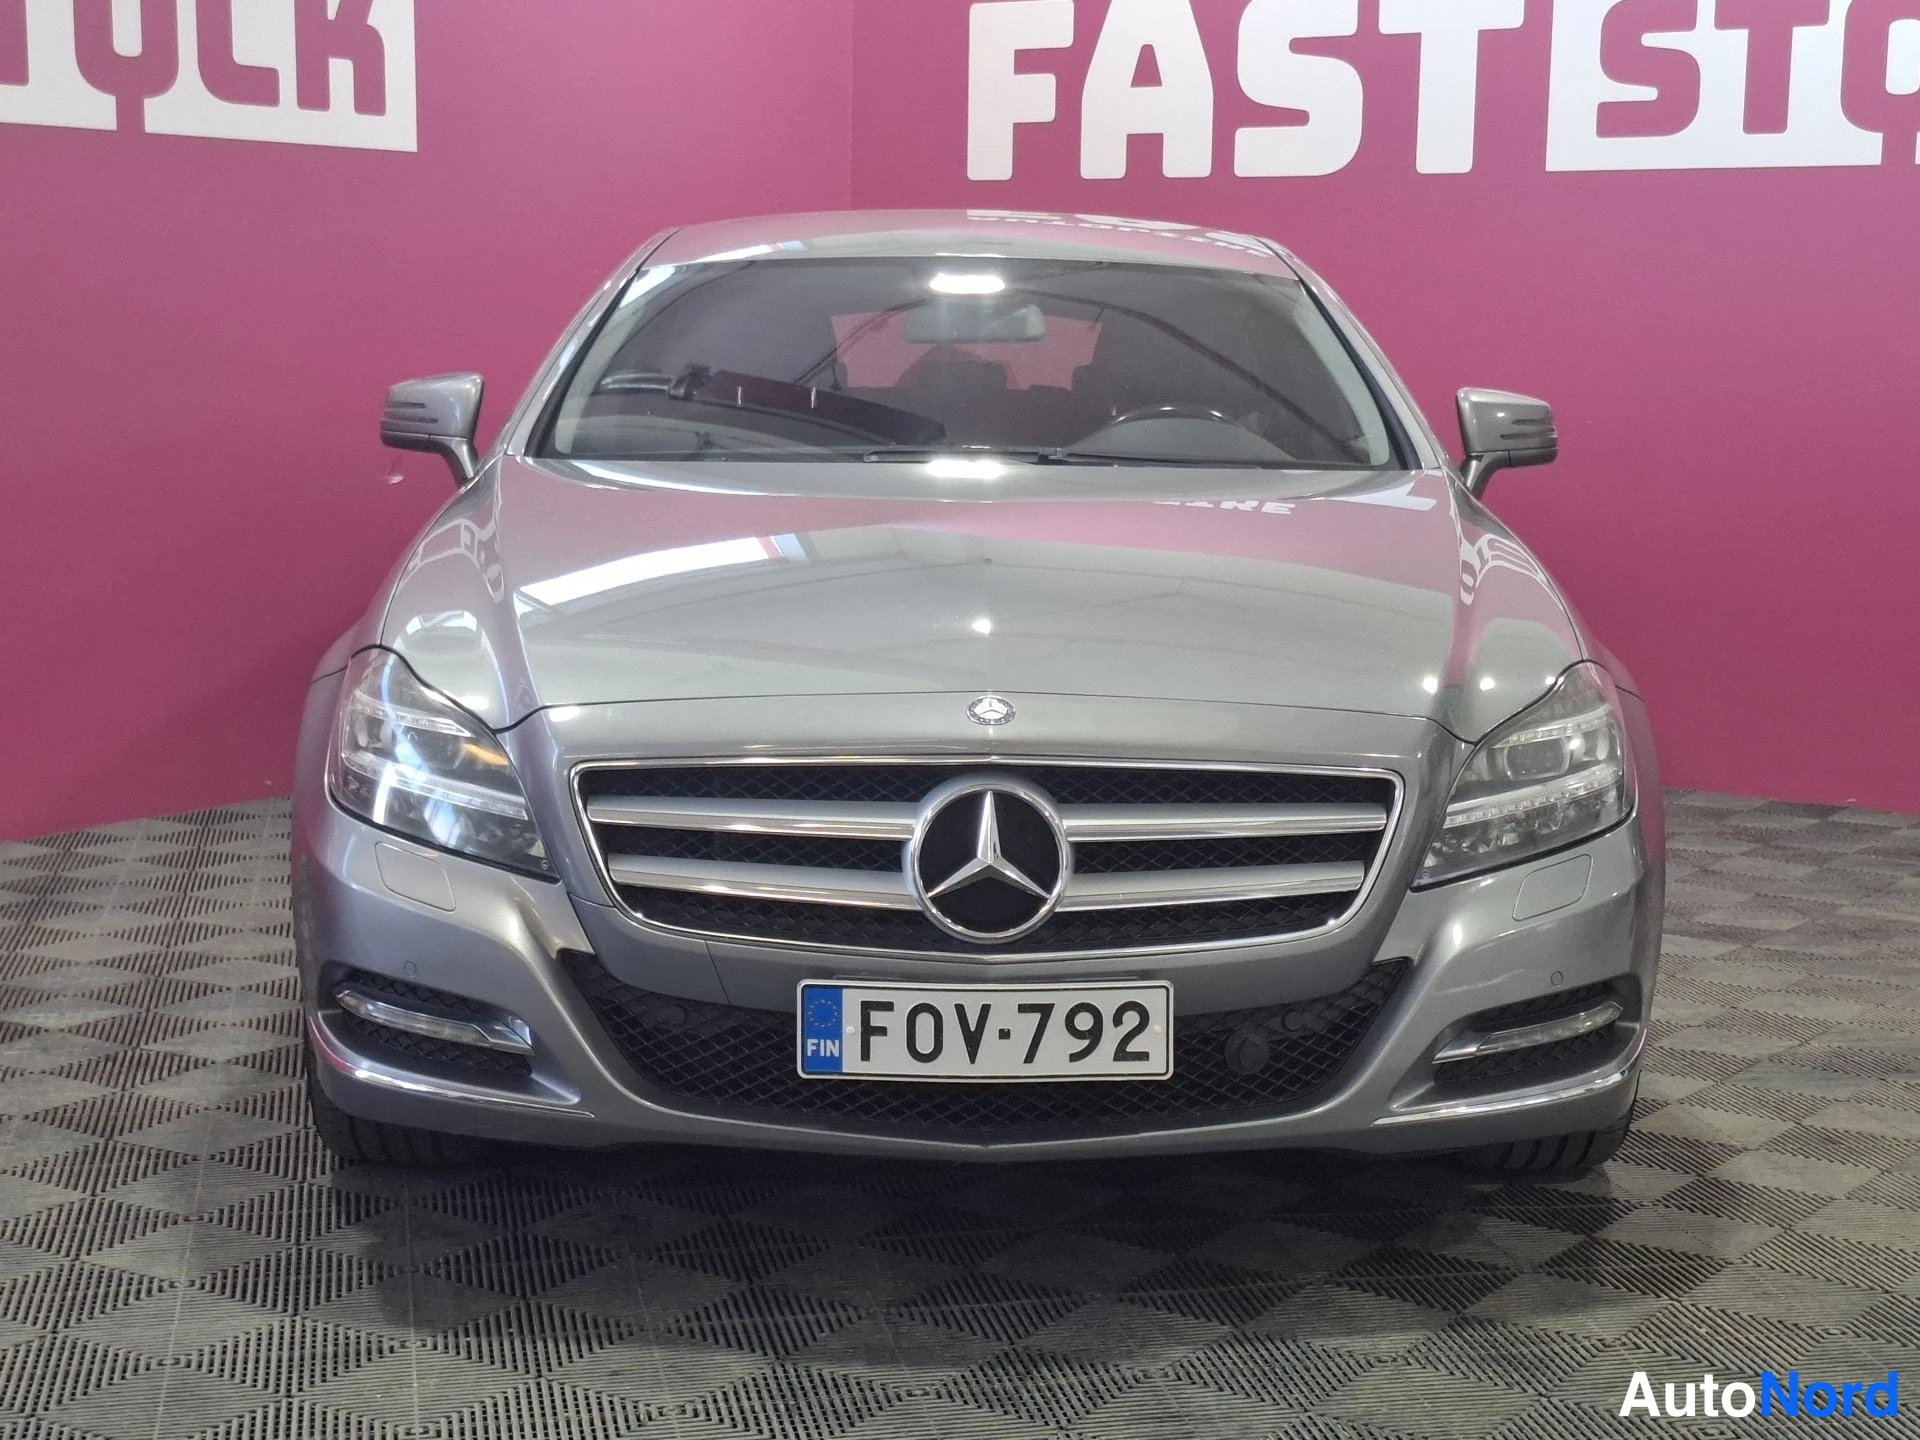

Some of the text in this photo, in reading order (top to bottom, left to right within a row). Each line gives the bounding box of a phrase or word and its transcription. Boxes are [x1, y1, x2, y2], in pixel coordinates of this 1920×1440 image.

[0, 0, 387, 117] OCK
[967, 0, 1525, 181] FAST
[806, 1038, 840, 1058] FIN
[859, 1000, 1151, 1065] FOV-792
